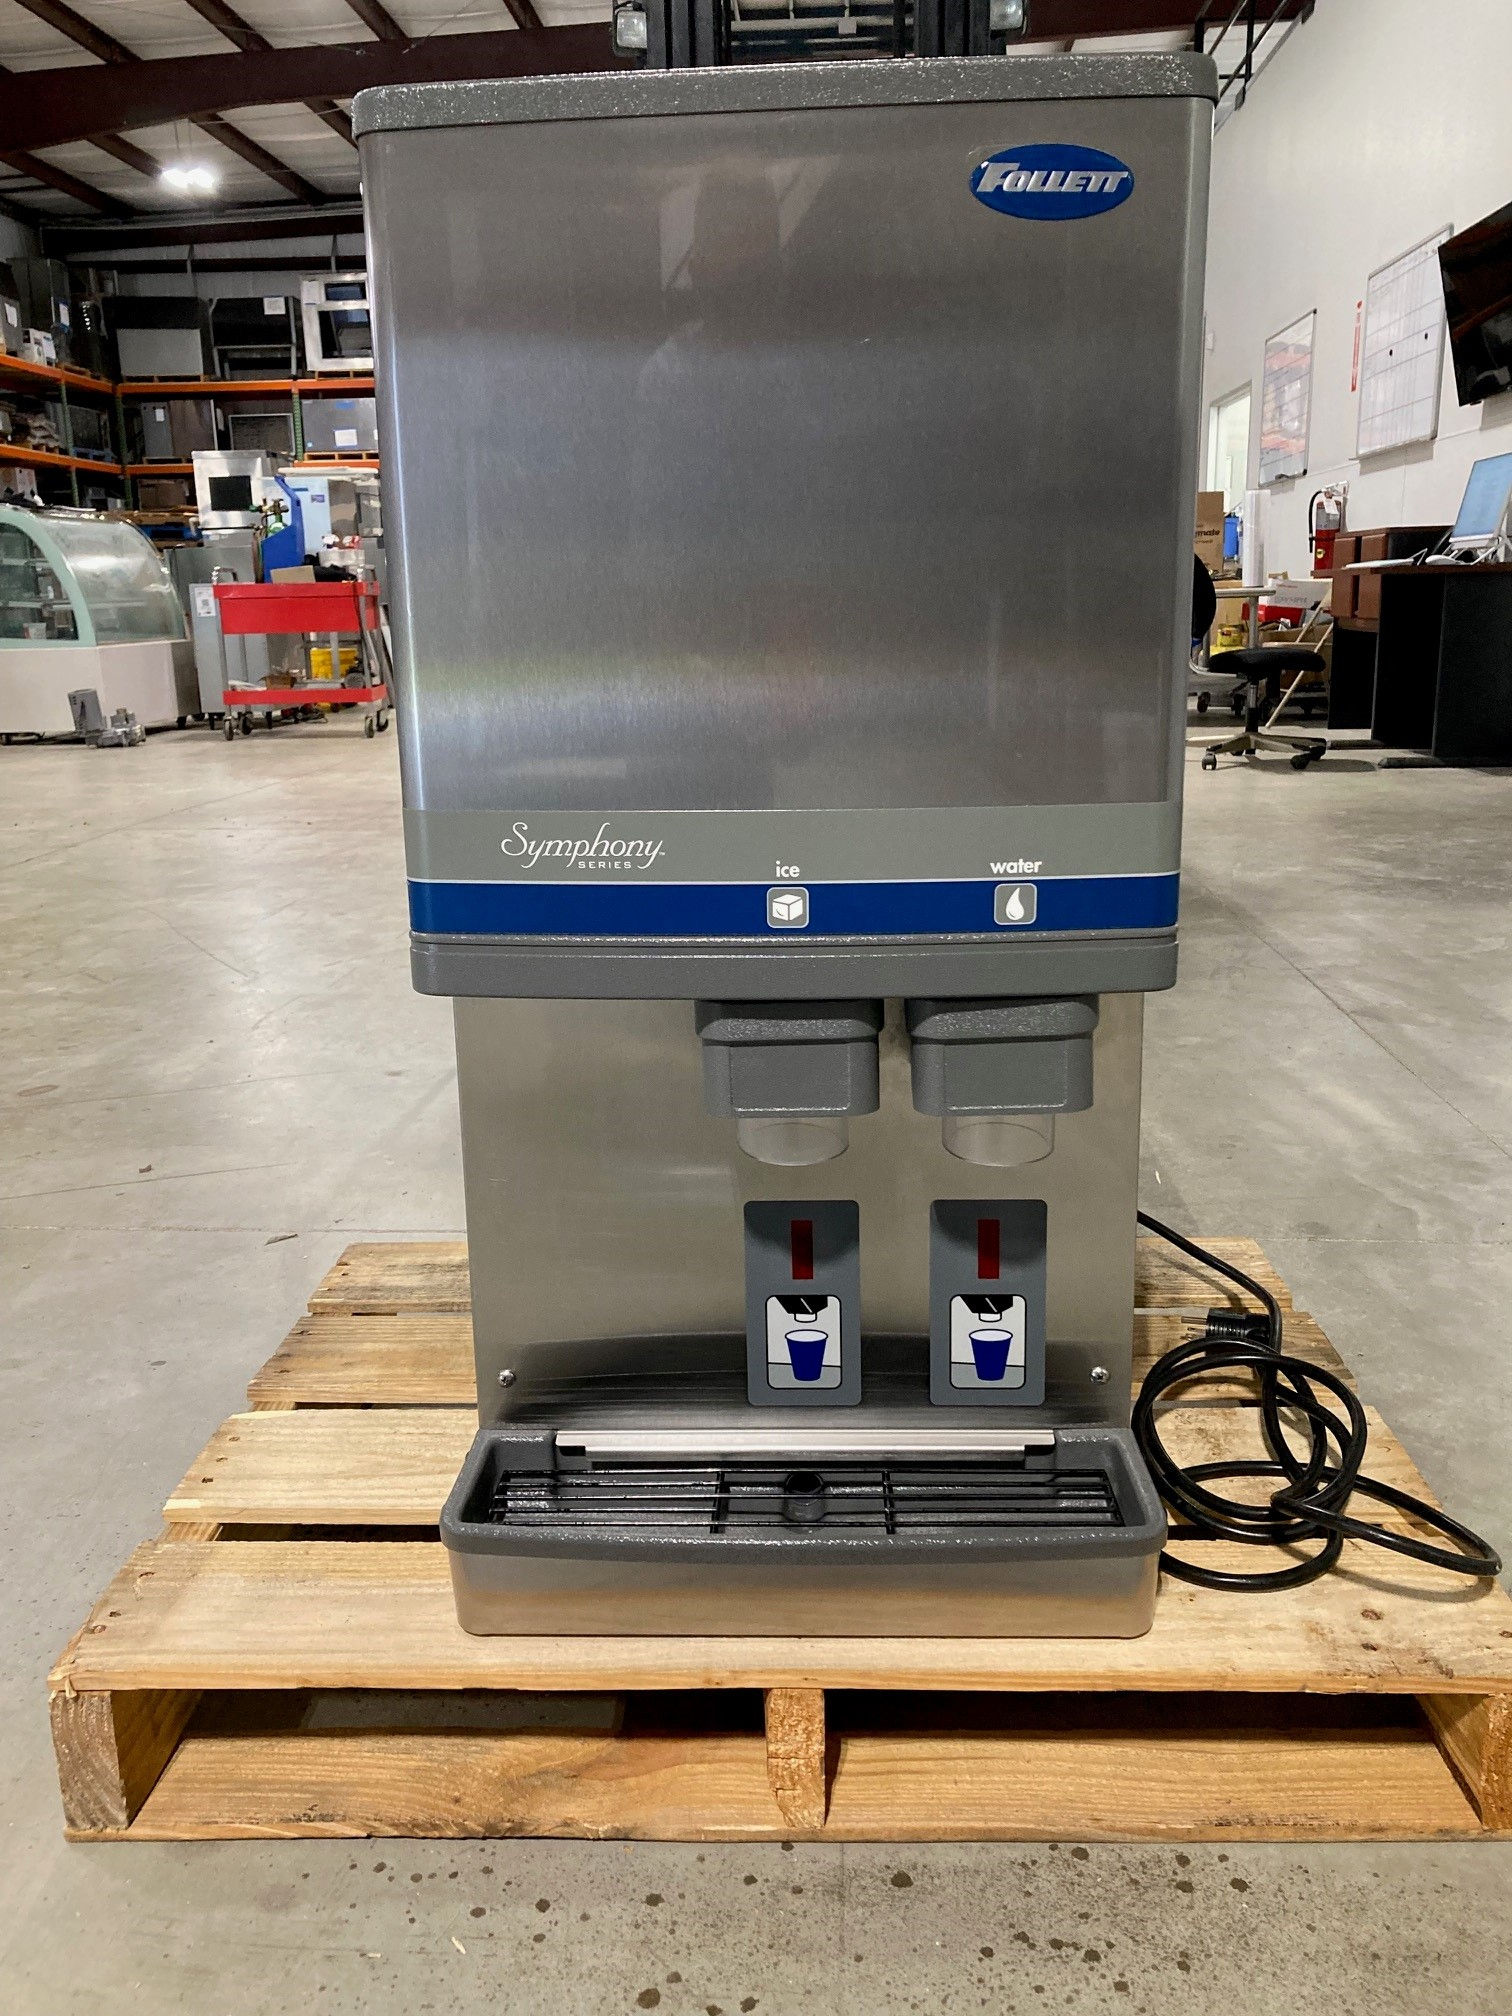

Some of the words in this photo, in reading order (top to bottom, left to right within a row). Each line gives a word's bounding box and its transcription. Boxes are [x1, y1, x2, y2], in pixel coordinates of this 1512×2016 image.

[976, 162, 1129, 193] FOLLETT
[577, 861, 632, 869] SERIES
[775, 860, 801, 878] ice
[989, 858, 1043, 875] water
